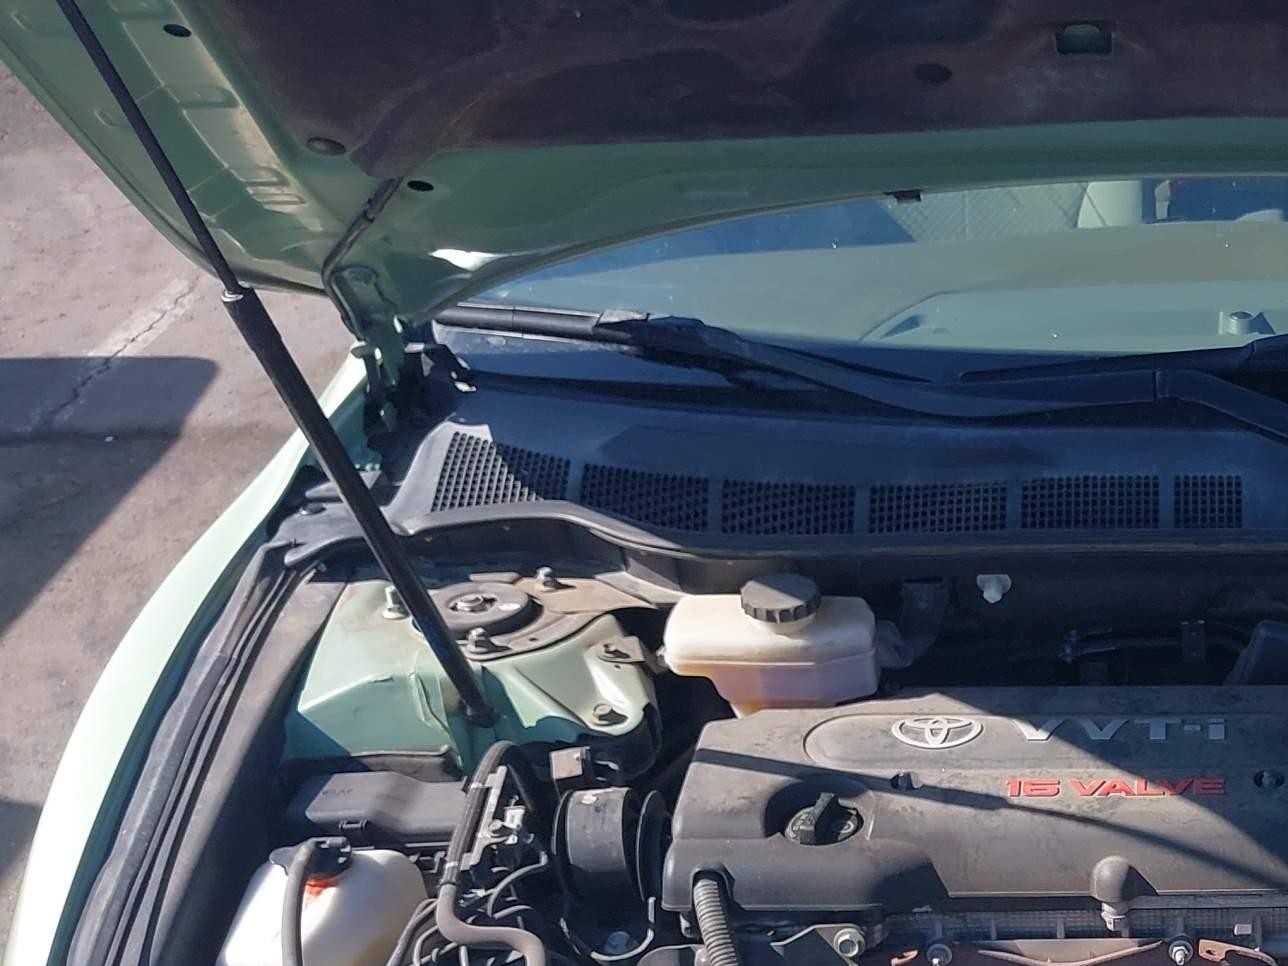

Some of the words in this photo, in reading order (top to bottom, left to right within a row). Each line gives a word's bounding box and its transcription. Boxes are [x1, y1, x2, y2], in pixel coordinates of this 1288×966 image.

[1011, 718, 1226, 741] VVT-i
[1007, 779, 1061, 798] 16
[1070, 776, 1226, 797] VALVE
